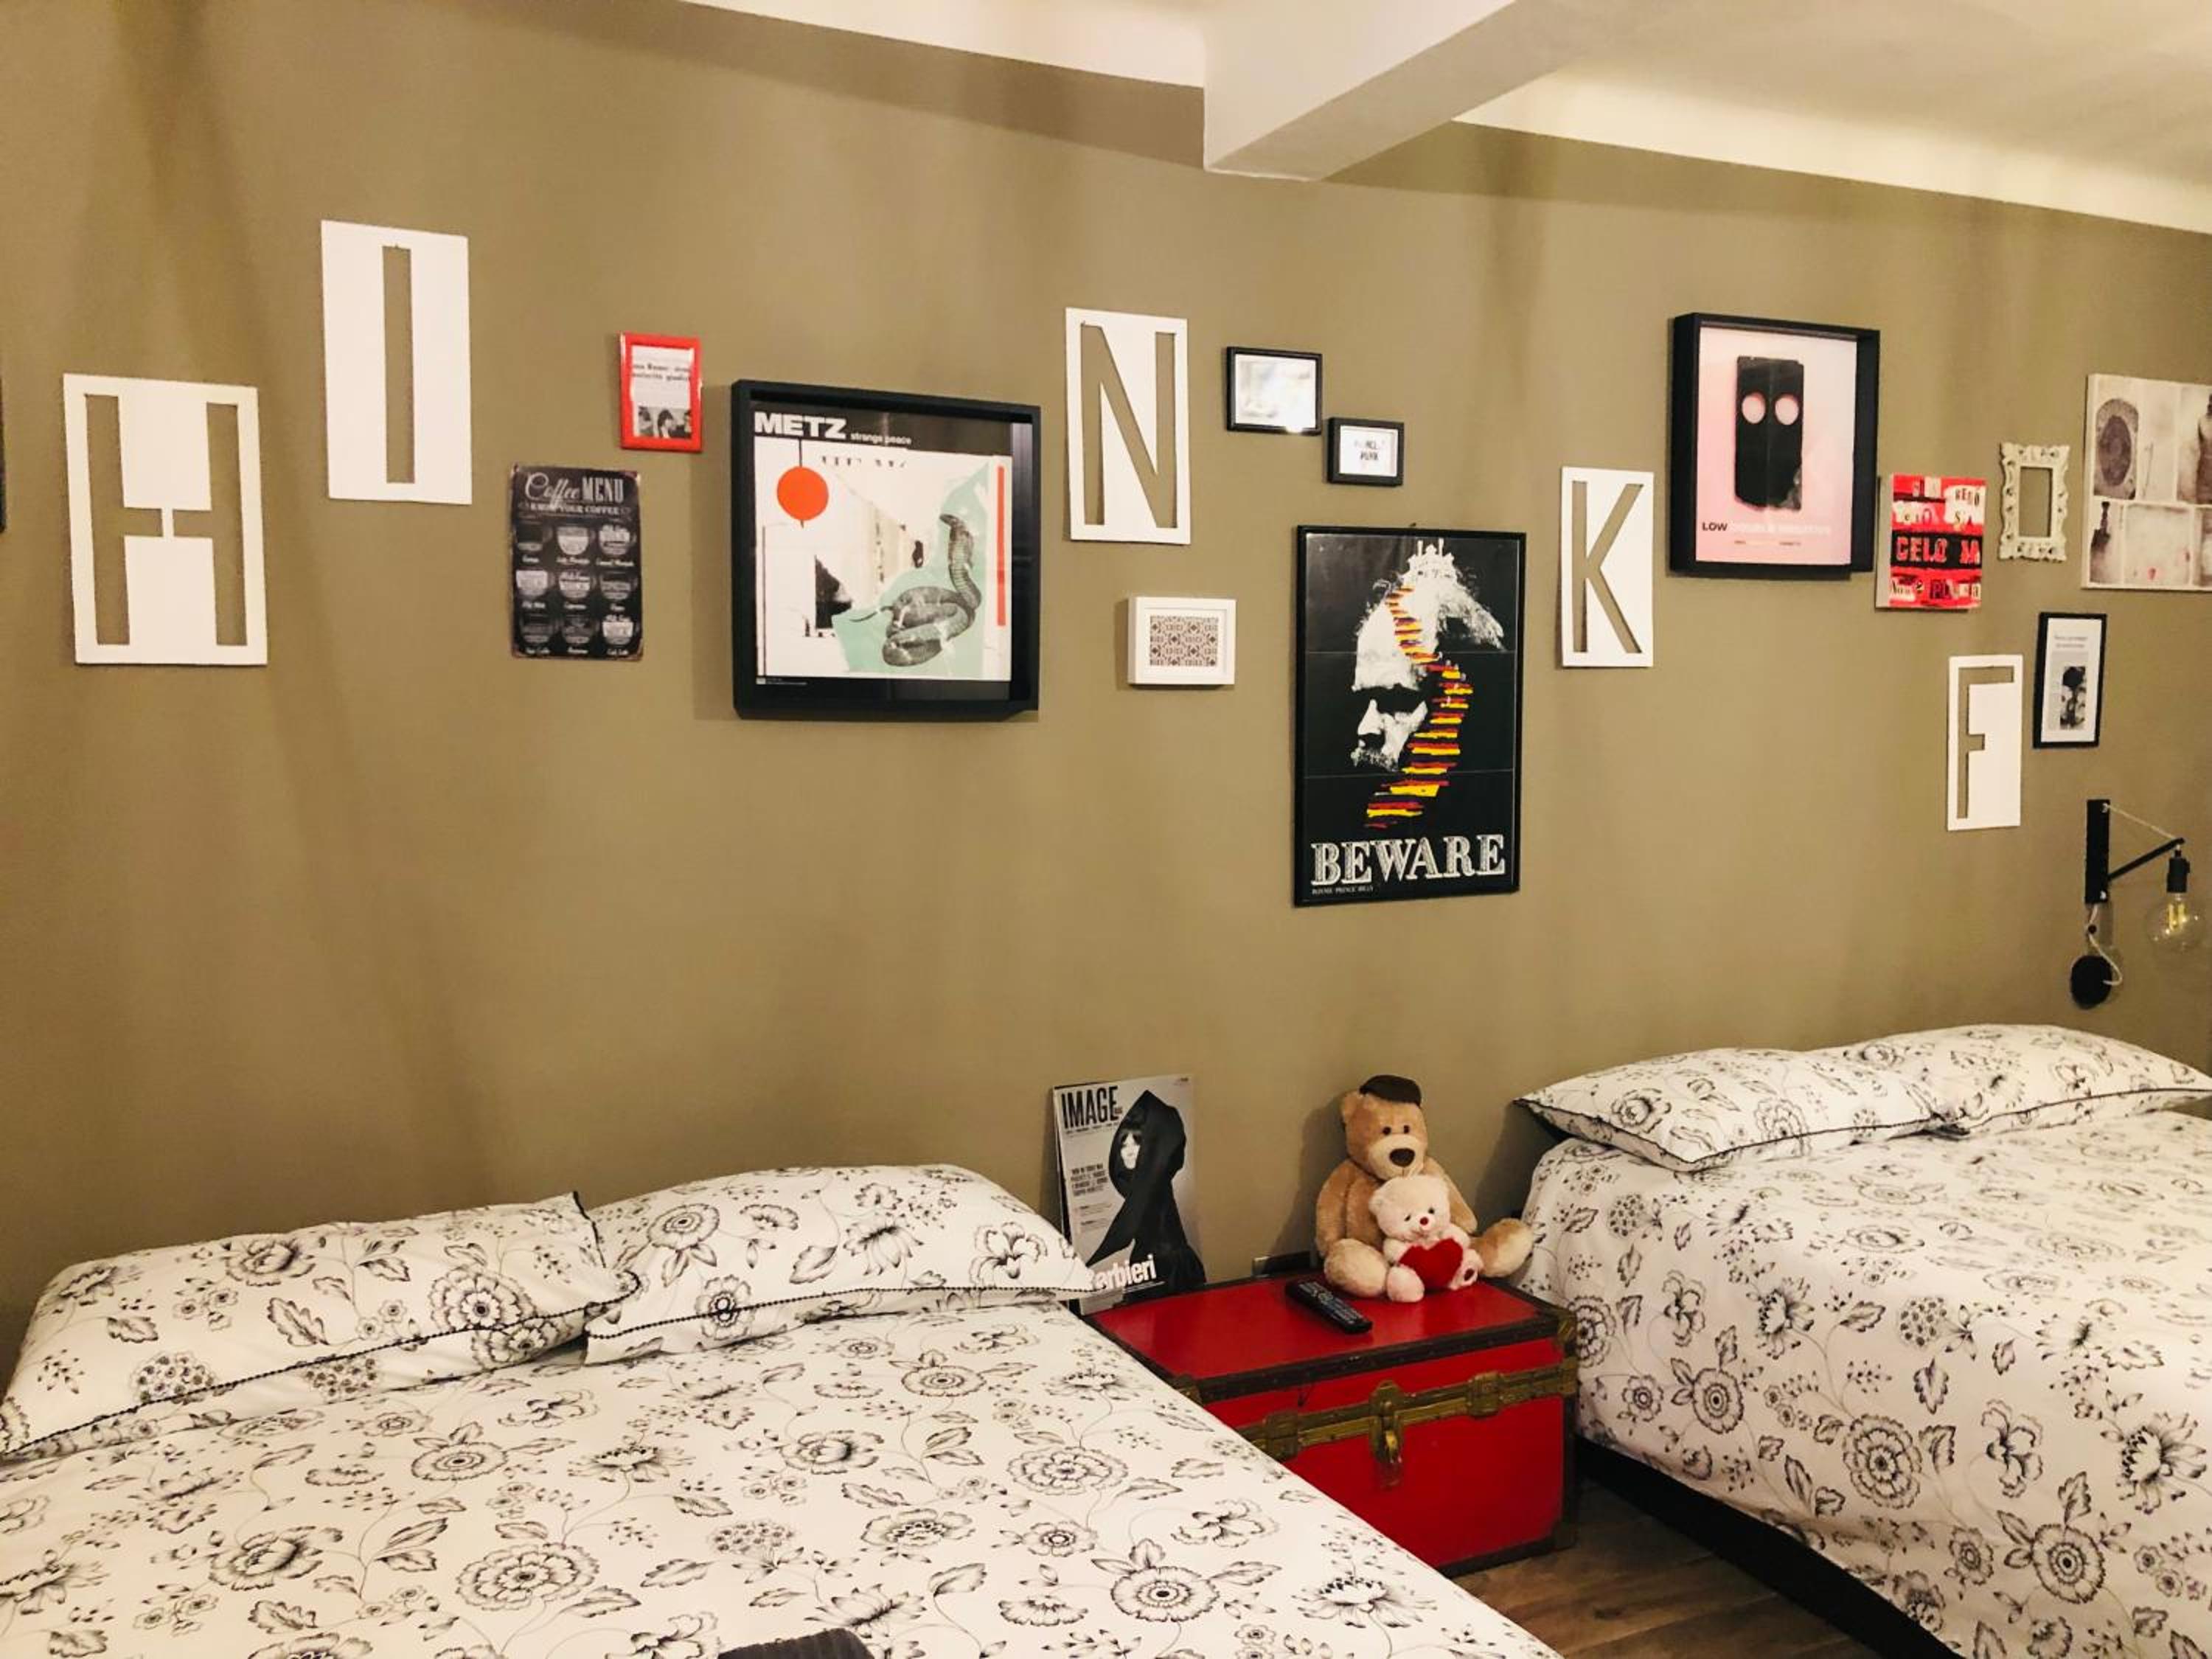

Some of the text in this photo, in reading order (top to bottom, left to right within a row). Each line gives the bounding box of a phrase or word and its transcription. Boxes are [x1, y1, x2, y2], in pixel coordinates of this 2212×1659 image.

[754, 411, 912, 445] METZ strange peace
[1080, 321, 1178, 529] N
[525, 472, 625, 509] Coffee MENU
[85, 394, 248, 647] H
[1702, 522, 1728, 532] LOW
[1571, 480, 1644, 653] K
[1957, 666, 2014, 818] F
[1311, 834, 1506, 886] BEWARE
[1061, 1085, 1119, 1129] IMAGE
